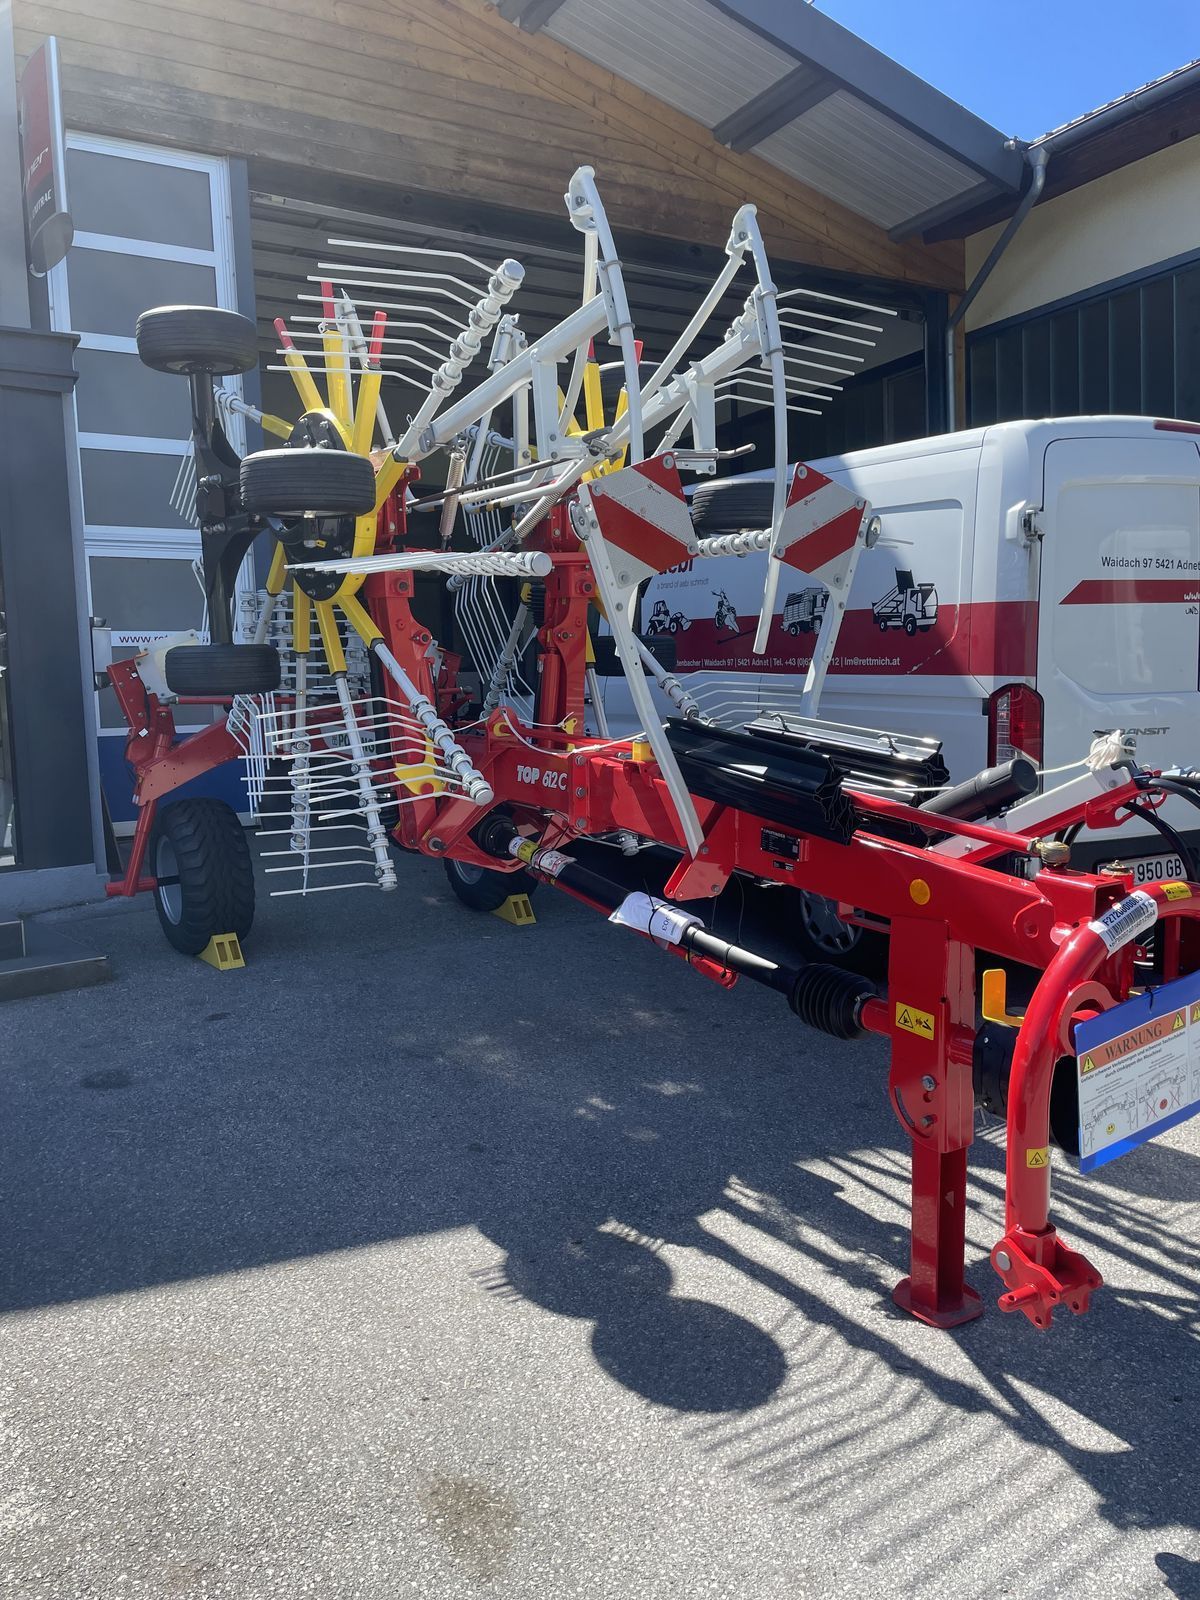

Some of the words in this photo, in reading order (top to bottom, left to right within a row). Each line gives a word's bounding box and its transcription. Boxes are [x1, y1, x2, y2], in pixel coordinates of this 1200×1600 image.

[1101, 556, 1140, 568] Waidach
[1142, 558, 1153, 568] 97
[1155, 559, 1174, 569] 5421
[517, 765, 540, 784] TOP
[1137, 863, 1162, 882] 950
[1166, 858, 1182, 878] GB
[1105, 1023, 1162, 1059] WARNUNG
